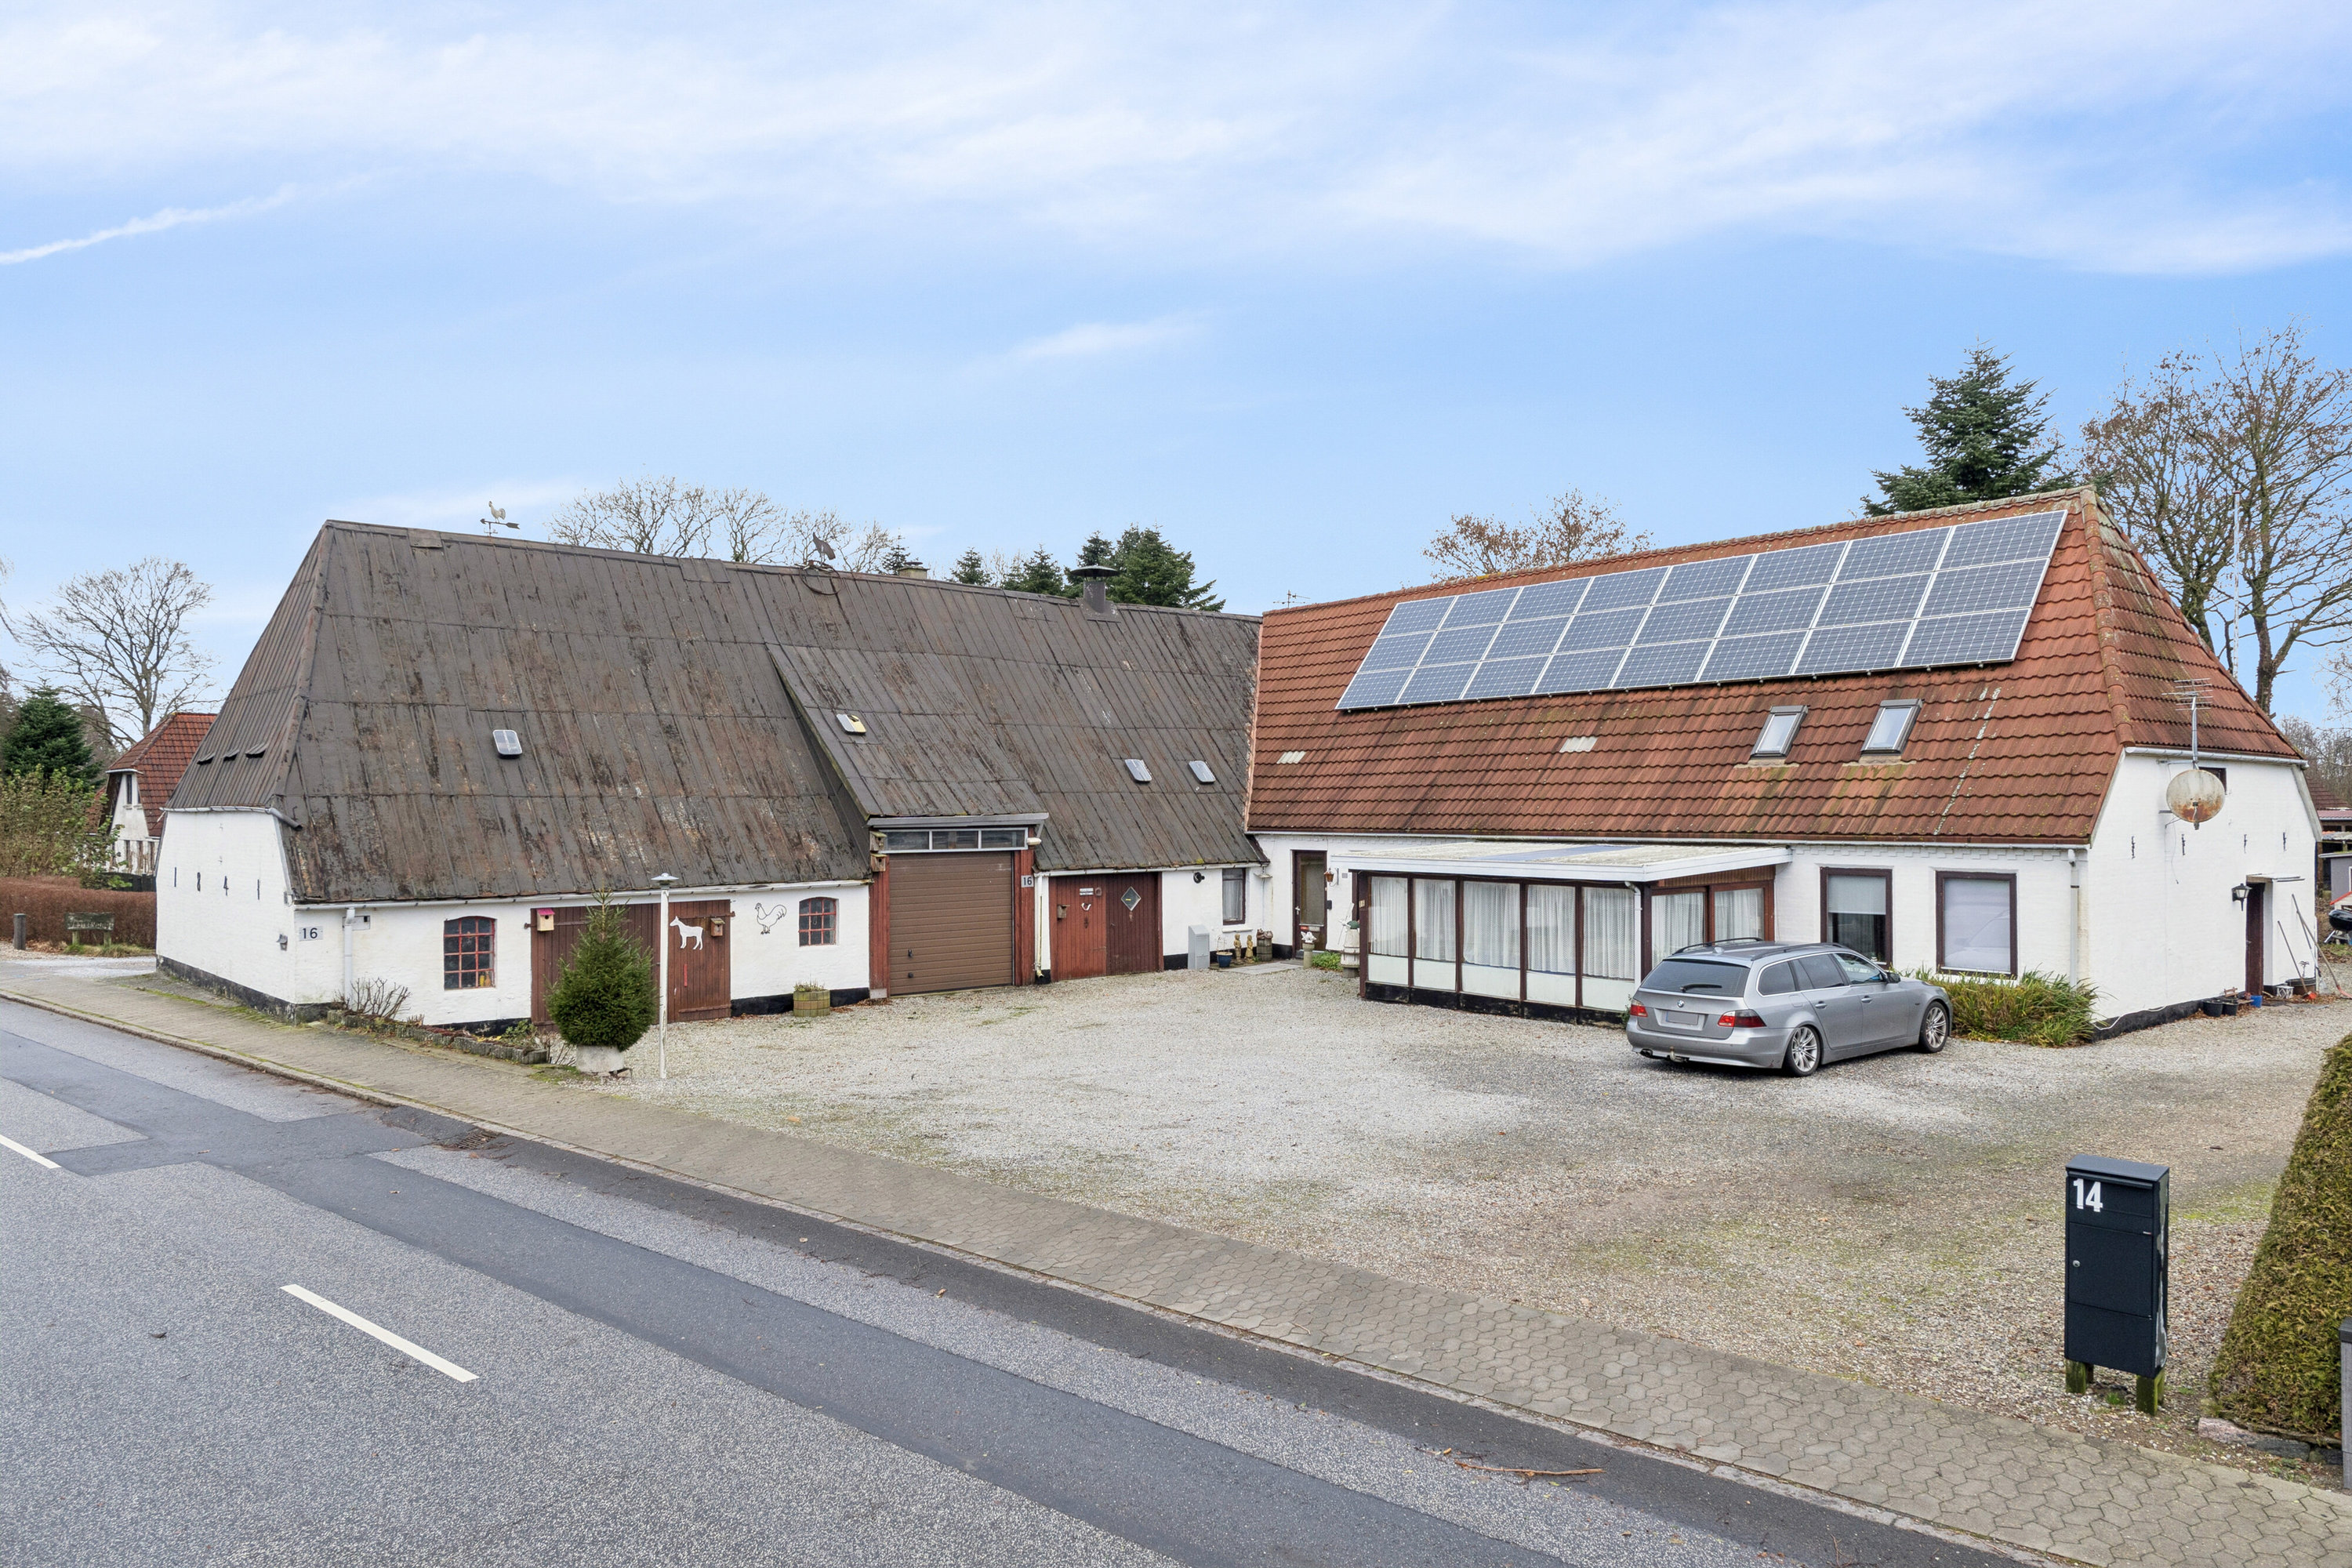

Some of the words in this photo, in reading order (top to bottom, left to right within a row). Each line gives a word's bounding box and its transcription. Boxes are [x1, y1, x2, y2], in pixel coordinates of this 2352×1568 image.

[1023, 877, 1032, 886] 16
[303, 927, 318, 939] 16
[2073, 1178, 2103, 1213] 14
